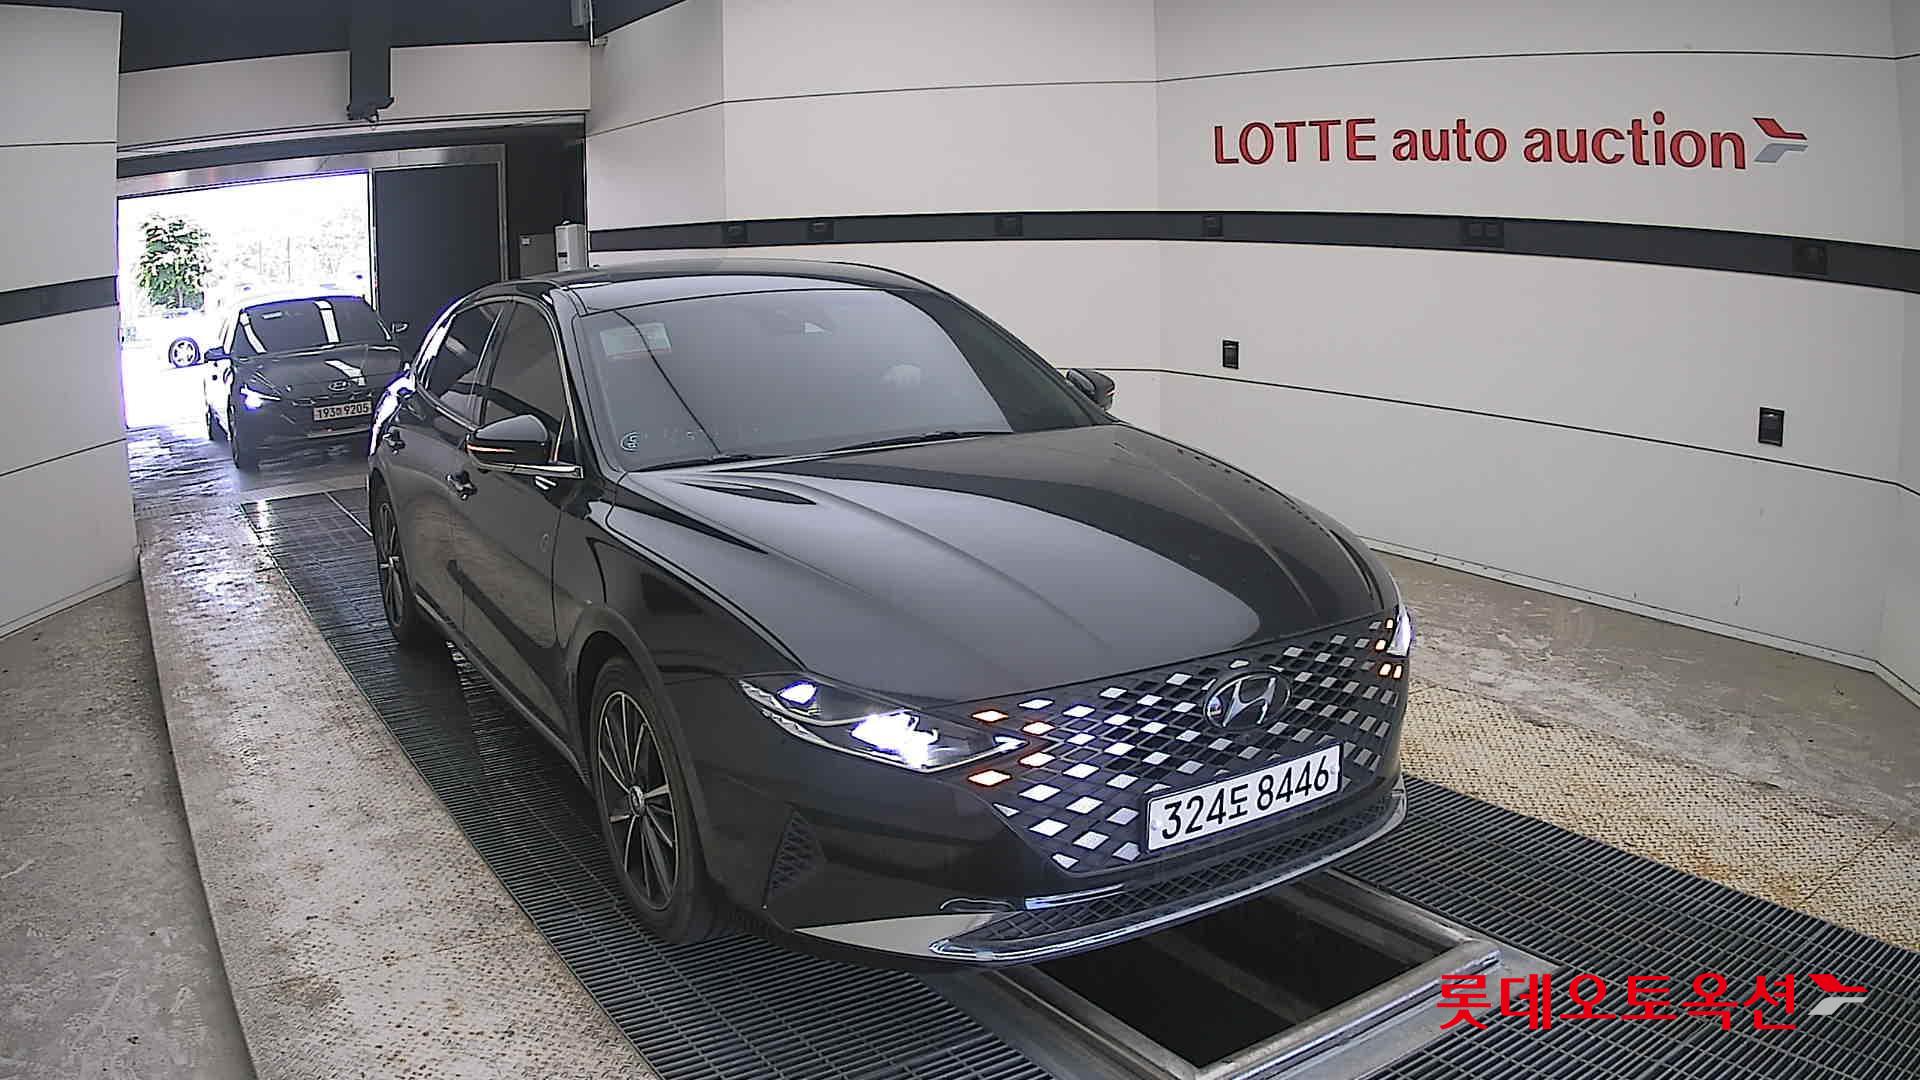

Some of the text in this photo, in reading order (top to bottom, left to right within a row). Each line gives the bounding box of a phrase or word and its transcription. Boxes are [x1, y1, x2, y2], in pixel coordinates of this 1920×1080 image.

[1214, 111, 1746, 170] LOTTE auto auction
[1161, 755, 1330, 839] 324도 8446
